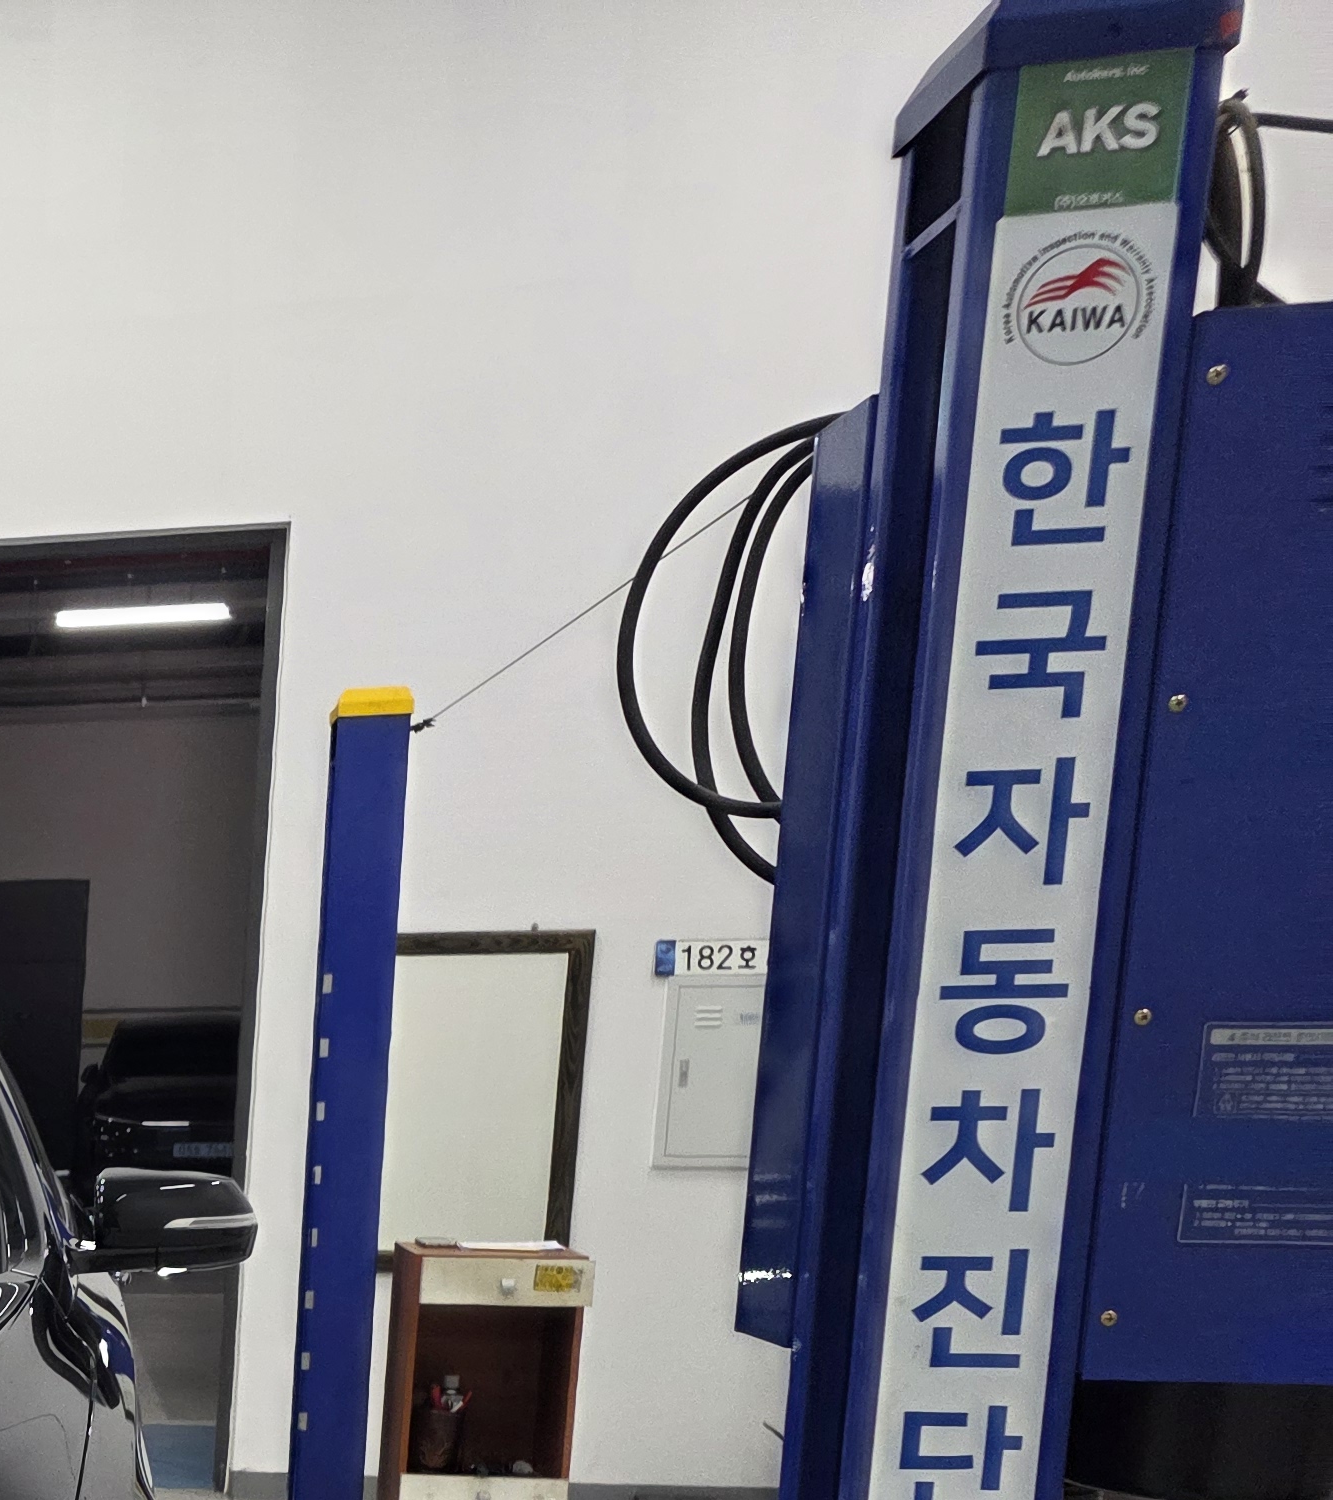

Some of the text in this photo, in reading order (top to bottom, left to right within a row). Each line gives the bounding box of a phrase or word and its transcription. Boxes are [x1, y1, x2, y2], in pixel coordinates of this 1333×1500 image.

[1036, 101, 1163, 158] AKS
[1025, 302, 1127, 335] KAIWA
[681, 944, 758, 971] 182호
